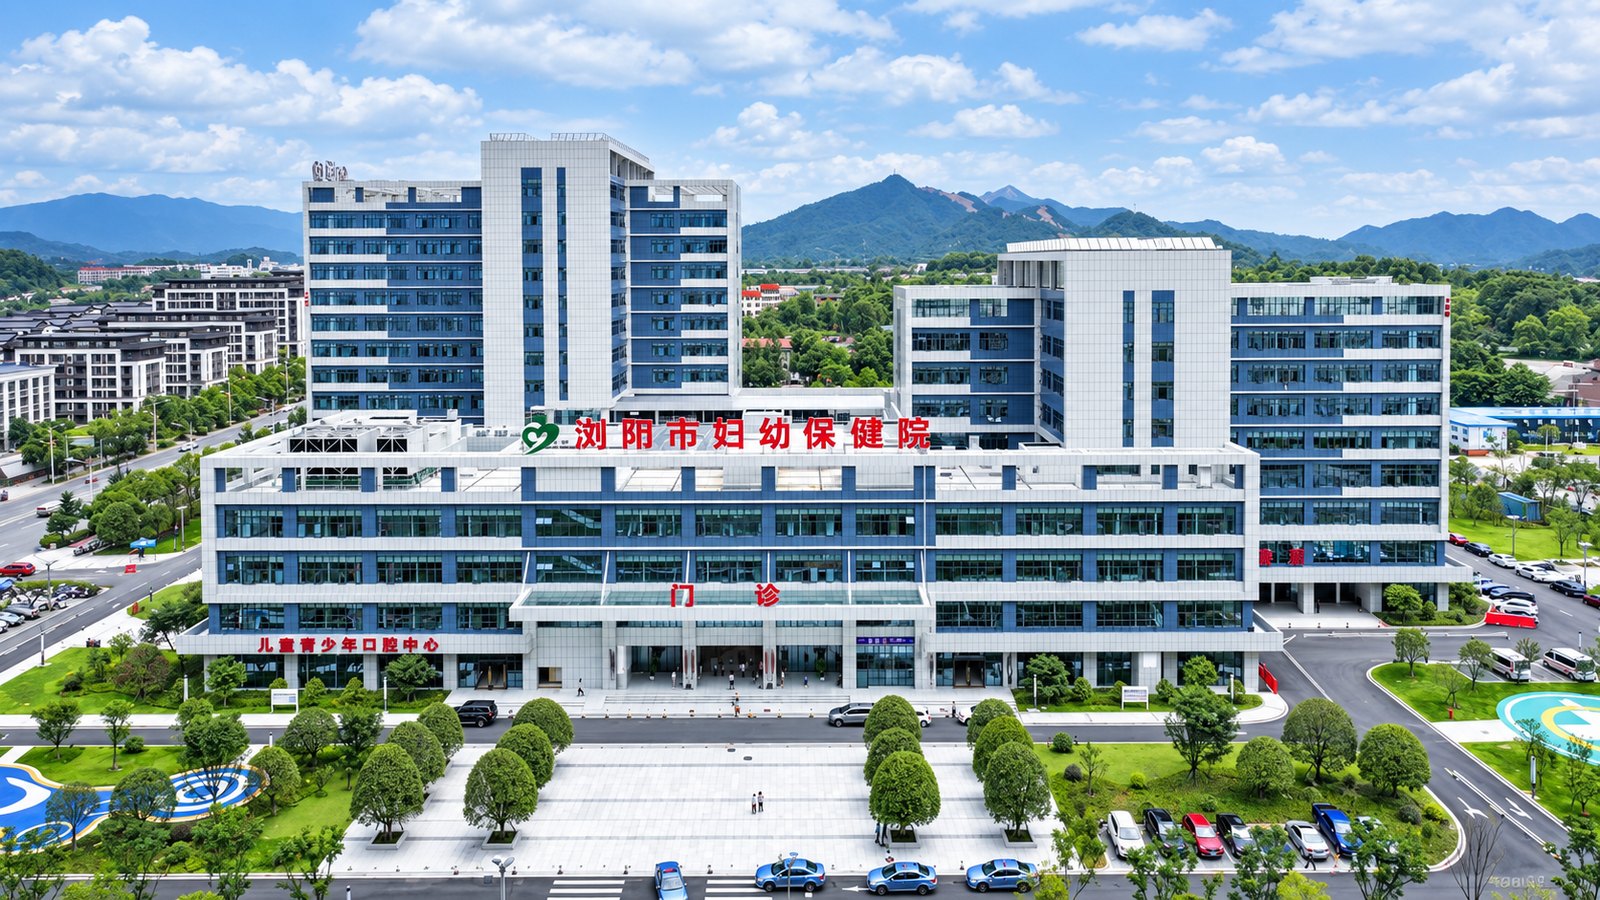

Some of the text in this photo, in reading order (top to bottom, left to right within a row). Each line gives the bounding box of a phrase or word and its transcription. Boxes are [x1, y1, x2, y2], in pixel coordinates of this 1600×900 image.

[575, 416, 932, 450] 浏阳市妇幼保健院
[670, 583, 781, 608] 门诊
[257, 636, 440, 653] 儿童青少年口腔中心
